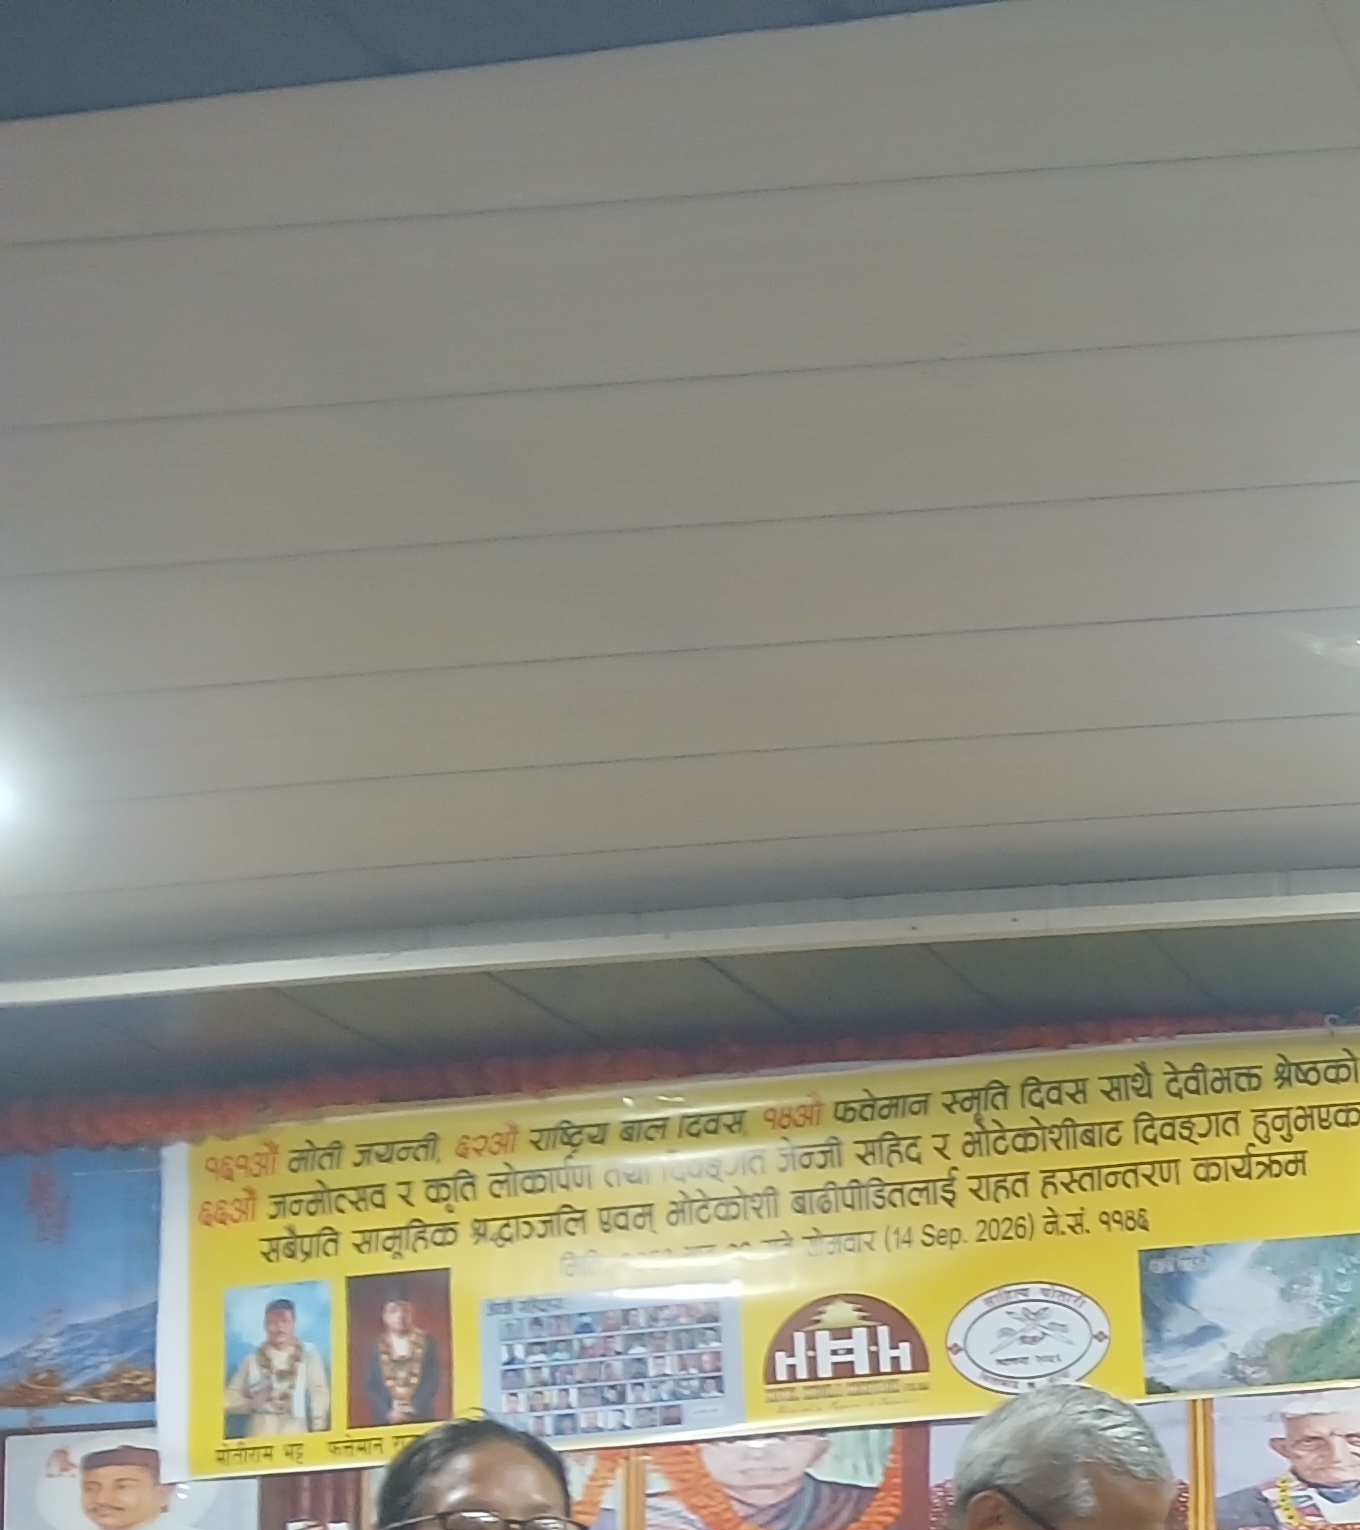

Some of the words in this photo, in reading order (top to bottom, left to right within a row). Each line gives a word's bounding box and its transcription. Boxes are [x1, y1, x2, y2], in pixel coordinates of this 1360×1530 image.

[620, 1114, 668, 1143] बाल
[941, 1079, 1011, 1124] स्मृति
[1020, 1075, 1090, 1110] दिवस
[1099, 1061, 1154, 1102] साथै
[1163, 1061, 1263, 1099] देवीभक्त
[259, 1224, 343, 1262] सबैप्रति
[352, 1217, 459, 1260] सामूहिक
[598, 1202, 656, 1235] एवम्
[666, 1186, 781, 1227] भोटेकोशी
[791, 1166, 958, 1217] बाढीपीडितलाई
[967, 1170, 1029, 1203] राहत
[1040, 1157, 1181, 1200] हस्तान्तरण
[1193, 1143, 1308, 1185] कार्यक्रम
[267, 1179, 388, 1222] जन्मोत्सव
[396, 1180, 415, 1206] र
[424, 1169, 479, 1213] कृति
[487, 1155, 593, 1198] लोकार्पण
[854, 1131, 922, 1168] सहिद
[932, 1134, 951, 1160] र
[962, 1118, 1125, 1159] भोटेकोशीबाट
[884, 1225, 914, 1252] (14
[921, 1223, 968, 1252] Sep.
[976, 1213, 1035, 1244] 2026)
